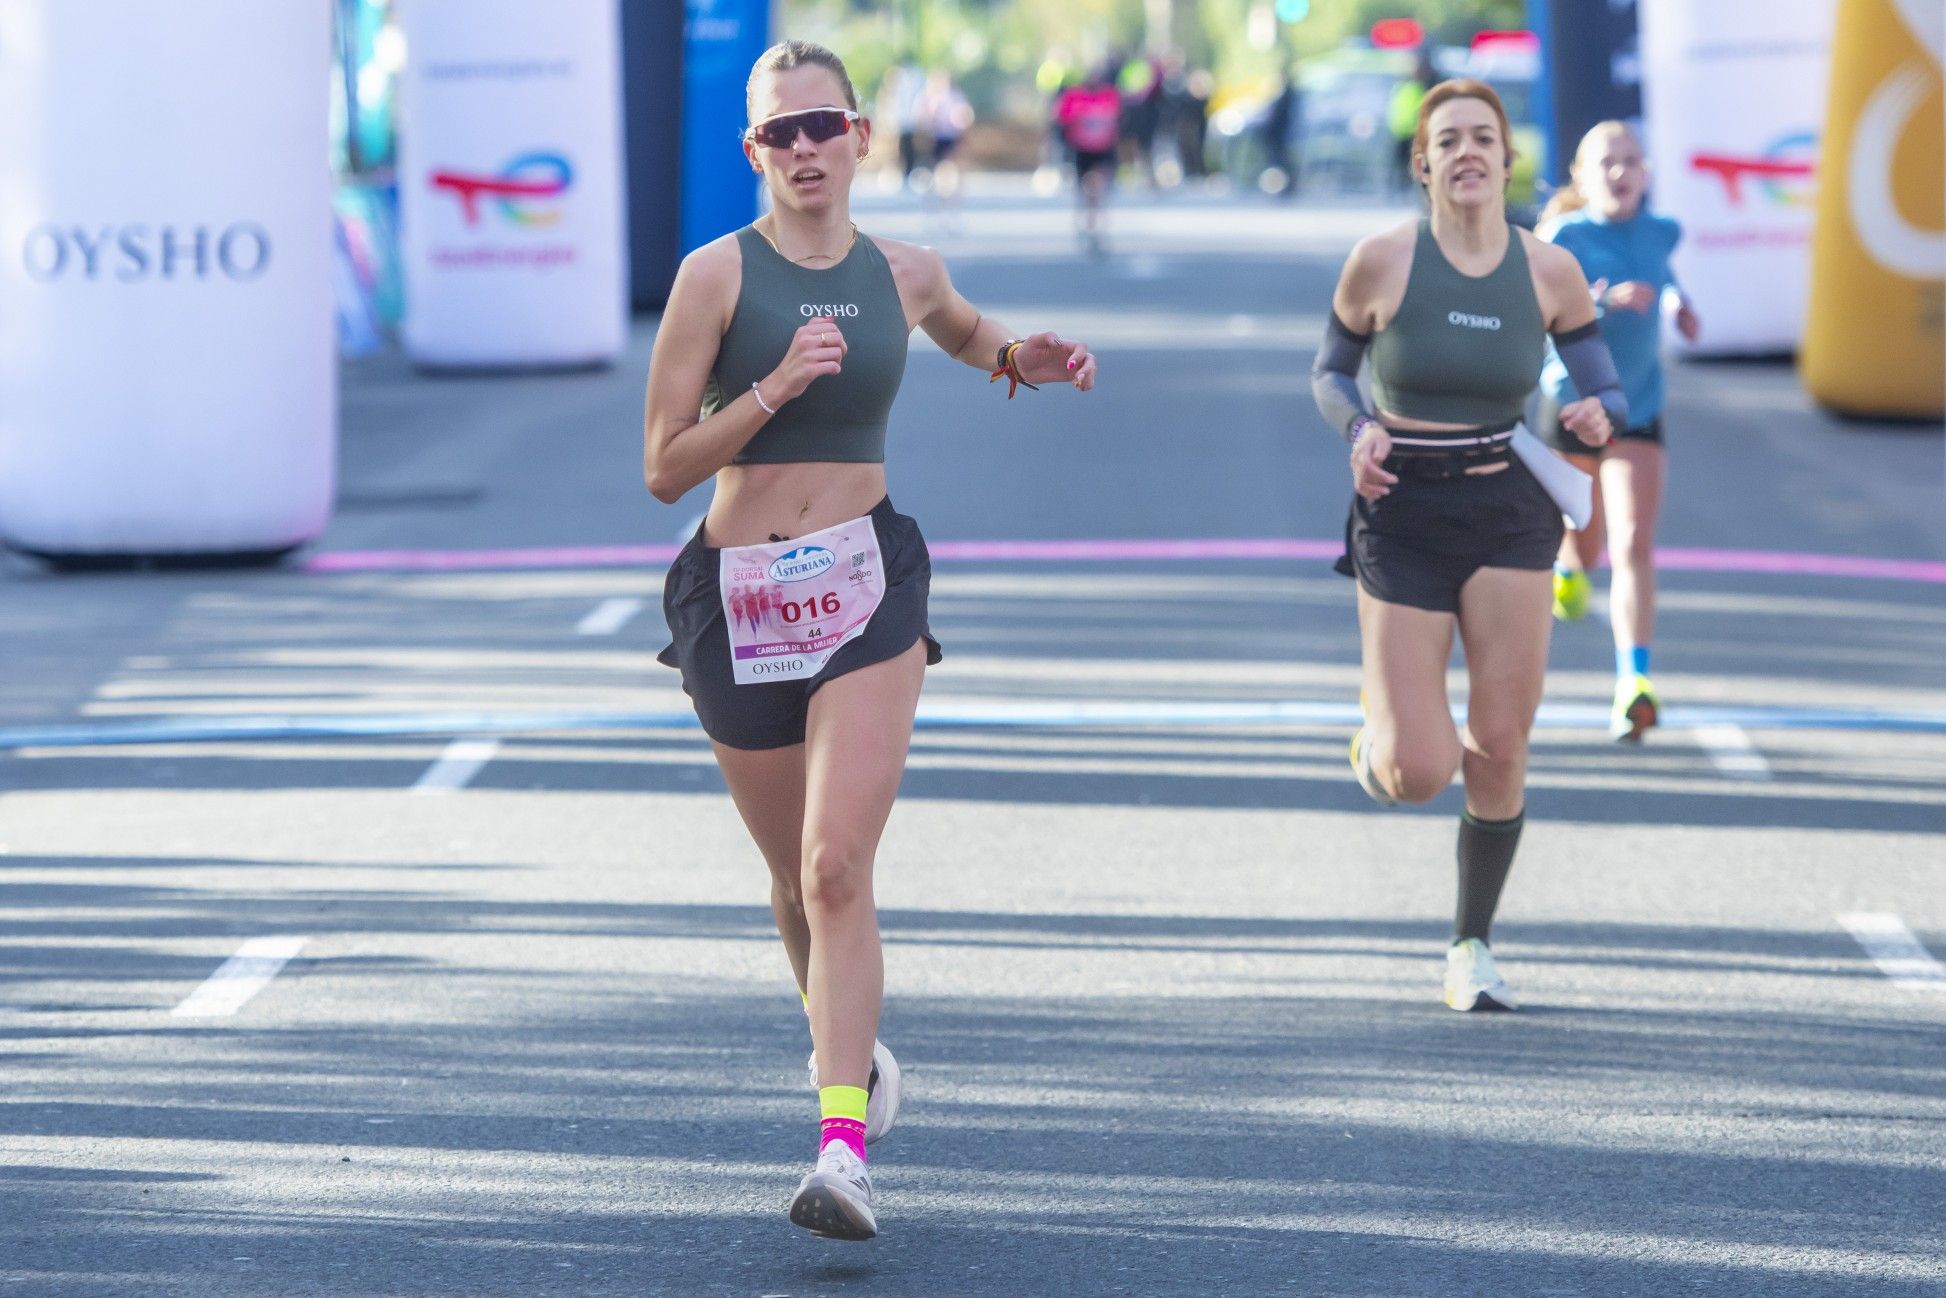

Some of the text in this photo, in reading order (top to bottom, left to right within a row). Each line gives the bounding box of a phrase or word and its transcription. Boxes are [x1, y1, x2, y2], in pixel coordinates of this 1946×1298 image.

[23, 220, 271, 284] OYSHO
[800, 303, 859, 317] OYSHO
[1447, 311, 1501, 331] OYSHO
[733, 571, 765, 581] SUMA
[781, 591, 841, 623] 016
[808, 628, 822, 638] 44
[755, 644, 790, 655] CARRERA
[791, 644, 801, 652] DE
[803, 643, 812, 651] LA
[814, 637, 838, 649] MUJER
[752, 659, 803, 675] OYSHO
